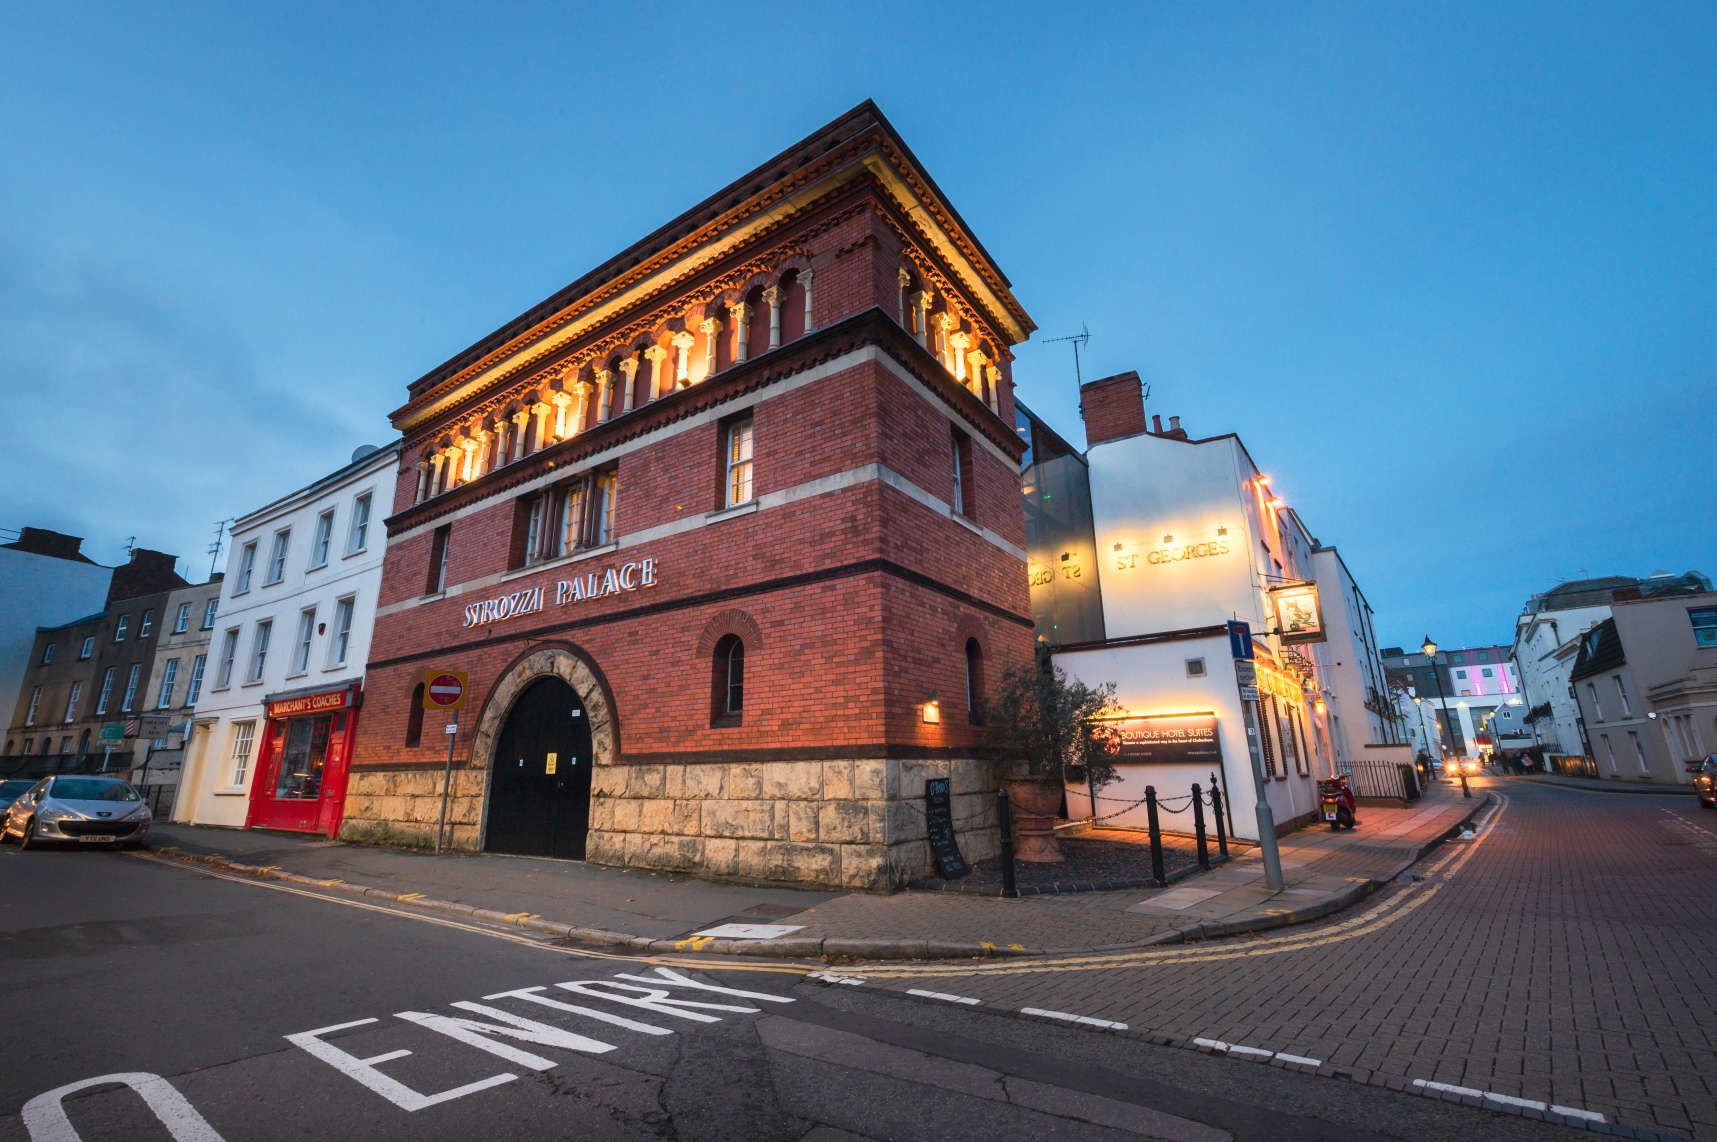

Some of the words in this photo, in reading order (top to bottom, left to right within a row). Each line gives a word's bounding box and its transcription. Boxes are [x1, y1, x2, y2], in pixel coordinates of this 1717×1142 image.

[1116, 553, 1139, 571] ST
[1147, 540, 1231, 566] GEORGES
[462, 586, 545, 628] STROZZI
[555, 557, 658, 607] PALACE
[273, 698, 311, 714] MARCHANT'S
[312, 693, 341, 708] COACHES
[1121, 730, 1160, 740] BOUTIQUE
[1161, 729, 1186, 738] HOTEL
[1188, 728, 1213, 738] SUITES
[282, 966, 796, 1112] ENTRY
